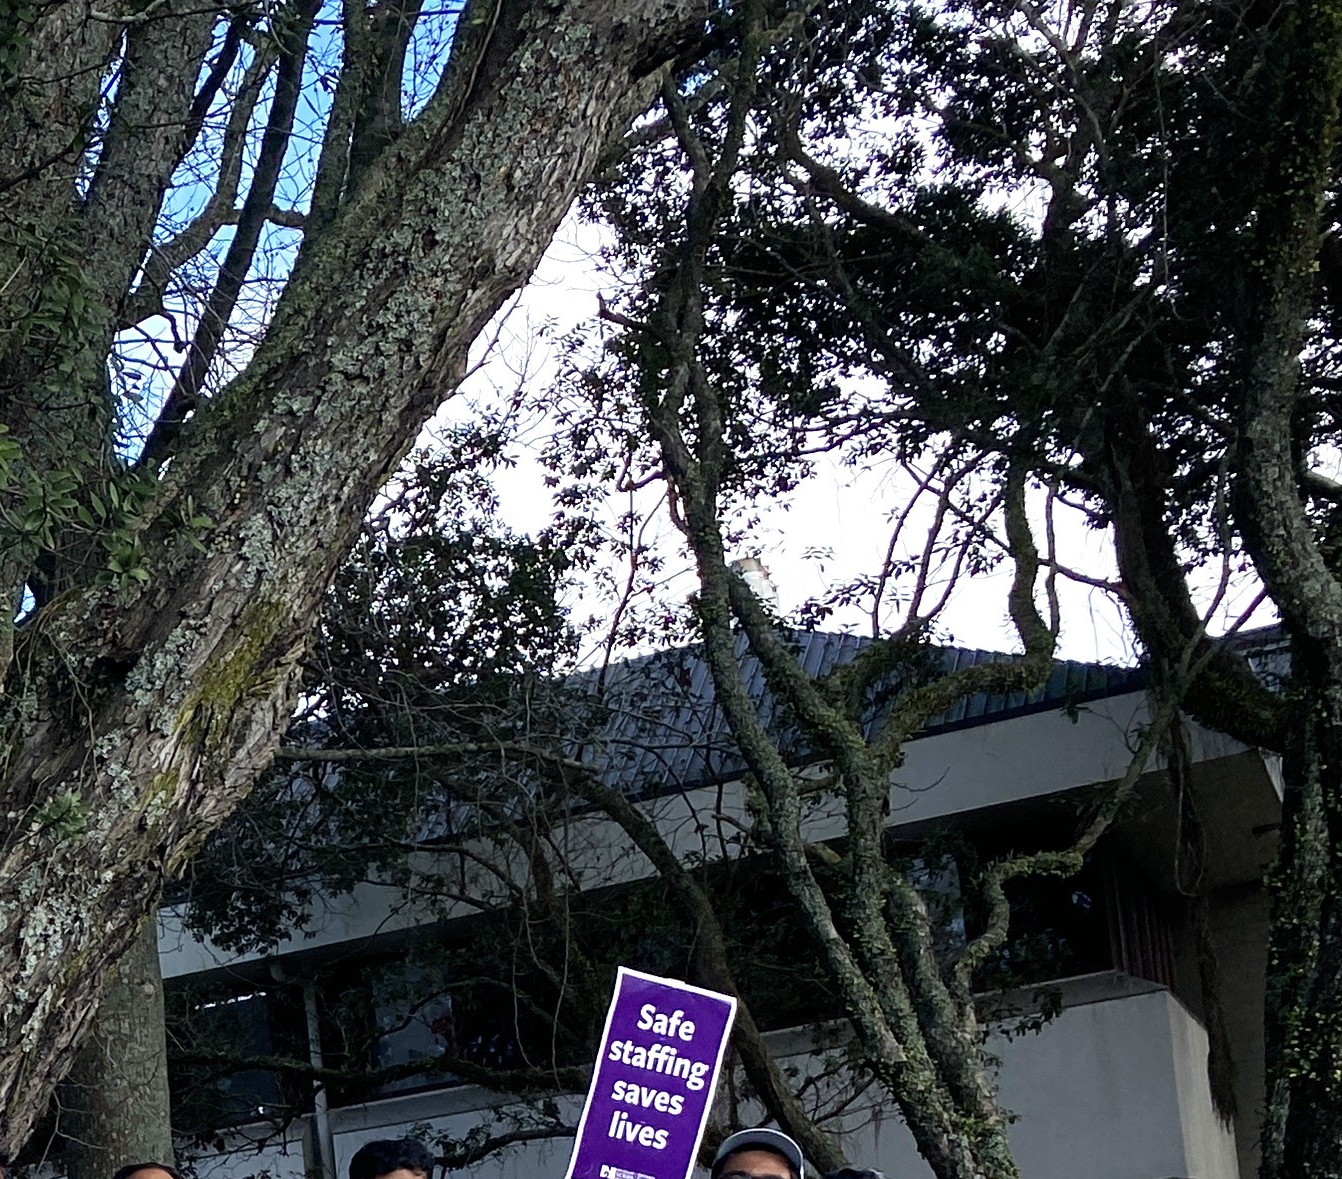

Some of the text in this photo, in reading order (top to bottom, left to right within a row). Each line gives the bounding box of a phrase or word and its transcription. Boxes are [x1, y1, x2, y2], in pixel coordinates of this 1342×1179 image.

[637, 1003, 695, 1041] Safe
[608, 1040, 710, 1091] staffing
[611, 1080, 685, 1115] saves
[608, 1110, 669, 1150] lives
